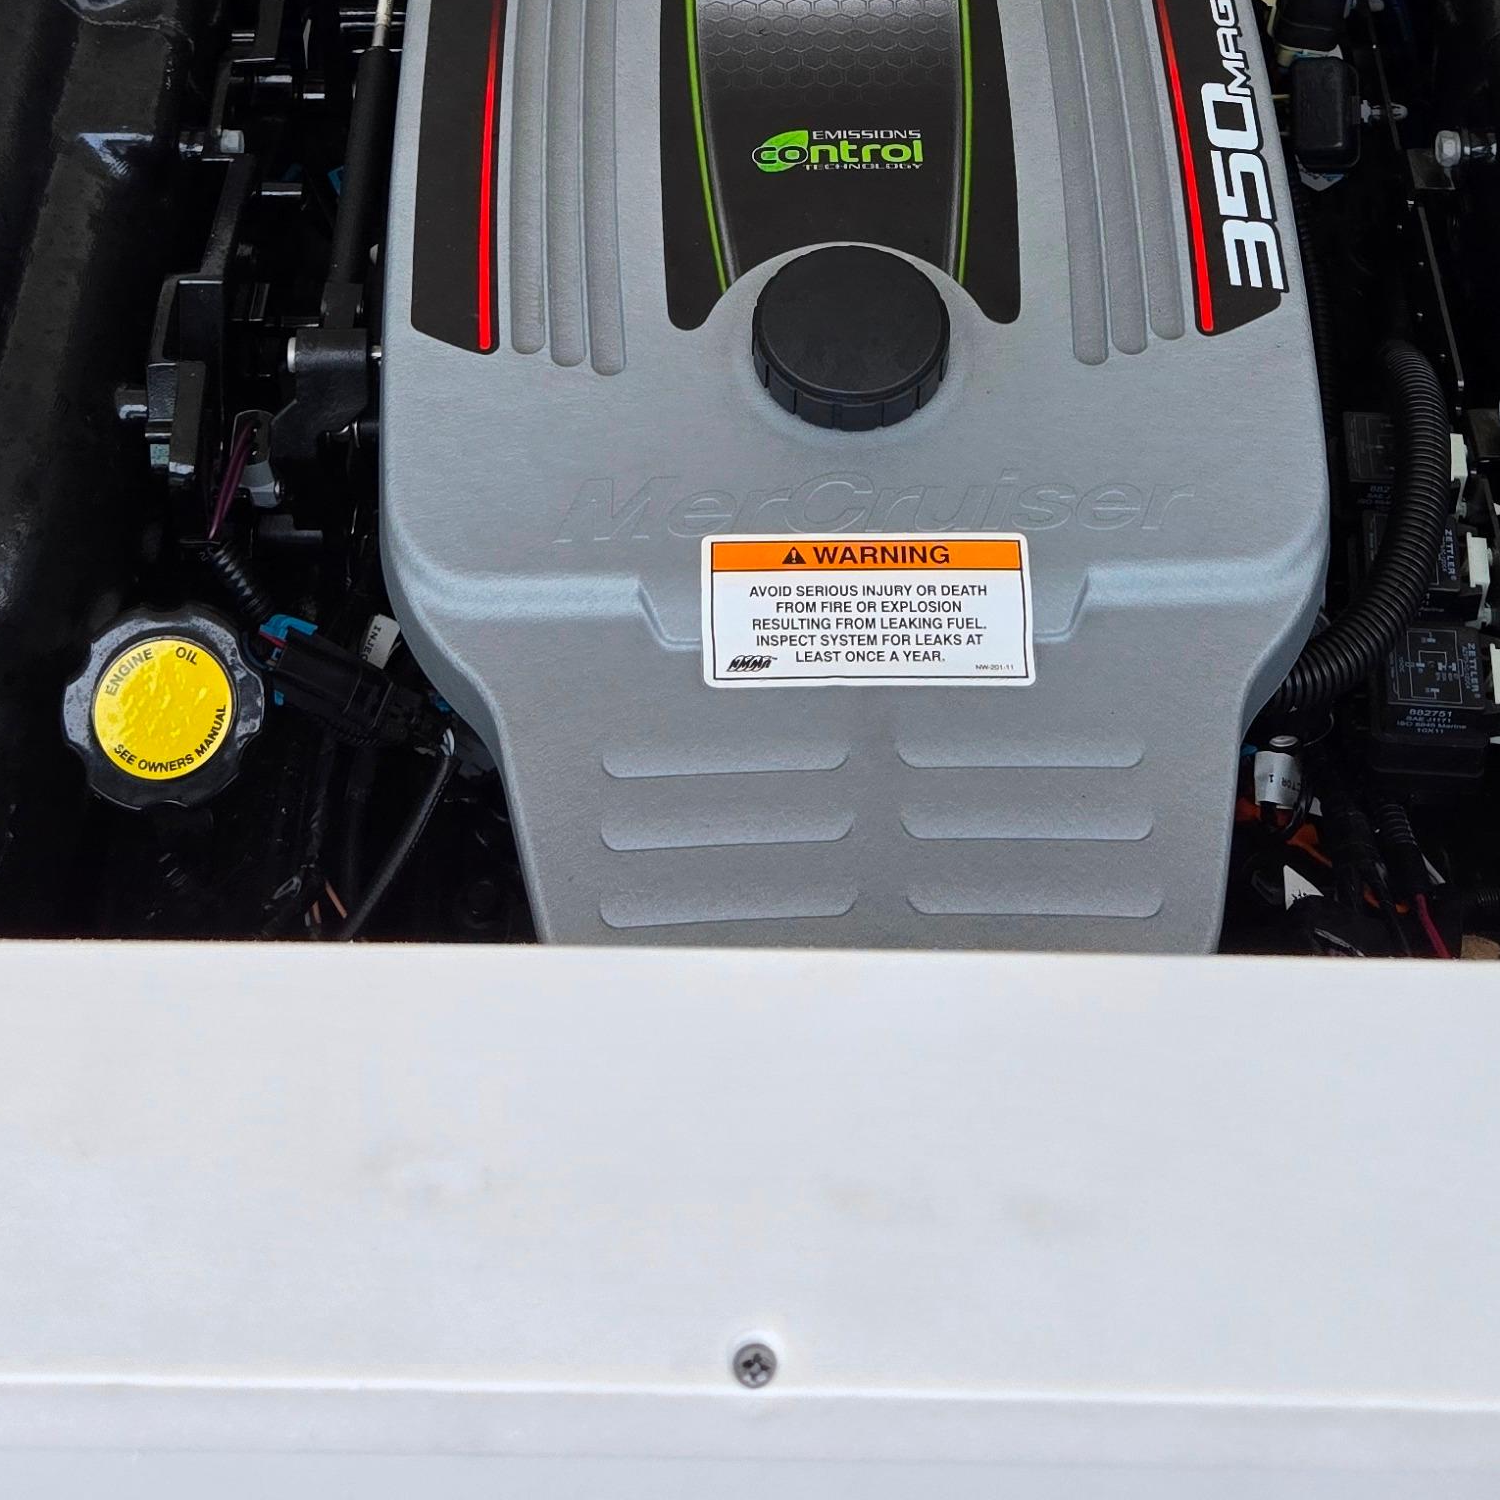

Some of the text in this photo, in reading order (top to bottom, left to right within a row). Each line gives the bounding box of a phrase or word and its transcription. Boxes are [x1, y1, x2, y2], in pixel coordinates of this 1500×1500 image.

[812, 130, 921, 140] EMISSIONS
[802, 163, 923, 171] TECHNOLOGY
[552, 469, 1195, 544] MerCruiser
[812, 545, 950, 564] WARNING
[750, 585, 987, 597] AVOID SERIOUS INJURY OR DEATH
[776, 601, 962, 613] FROM FIRE OR EXPLOSION
[752, 618, 987, 630] RESULTING FROM LEAKING FUEL.
[756, 634, 983, 646] INSPECT SYSTEM FOR LEAKS AT
[796, 650, 945, 662] LEAST ONCE A YEAR.
[106, 646, 199, 696] ENGINE OIL
[113, 705, 226, 773] SEE OWNERS MANUAL
